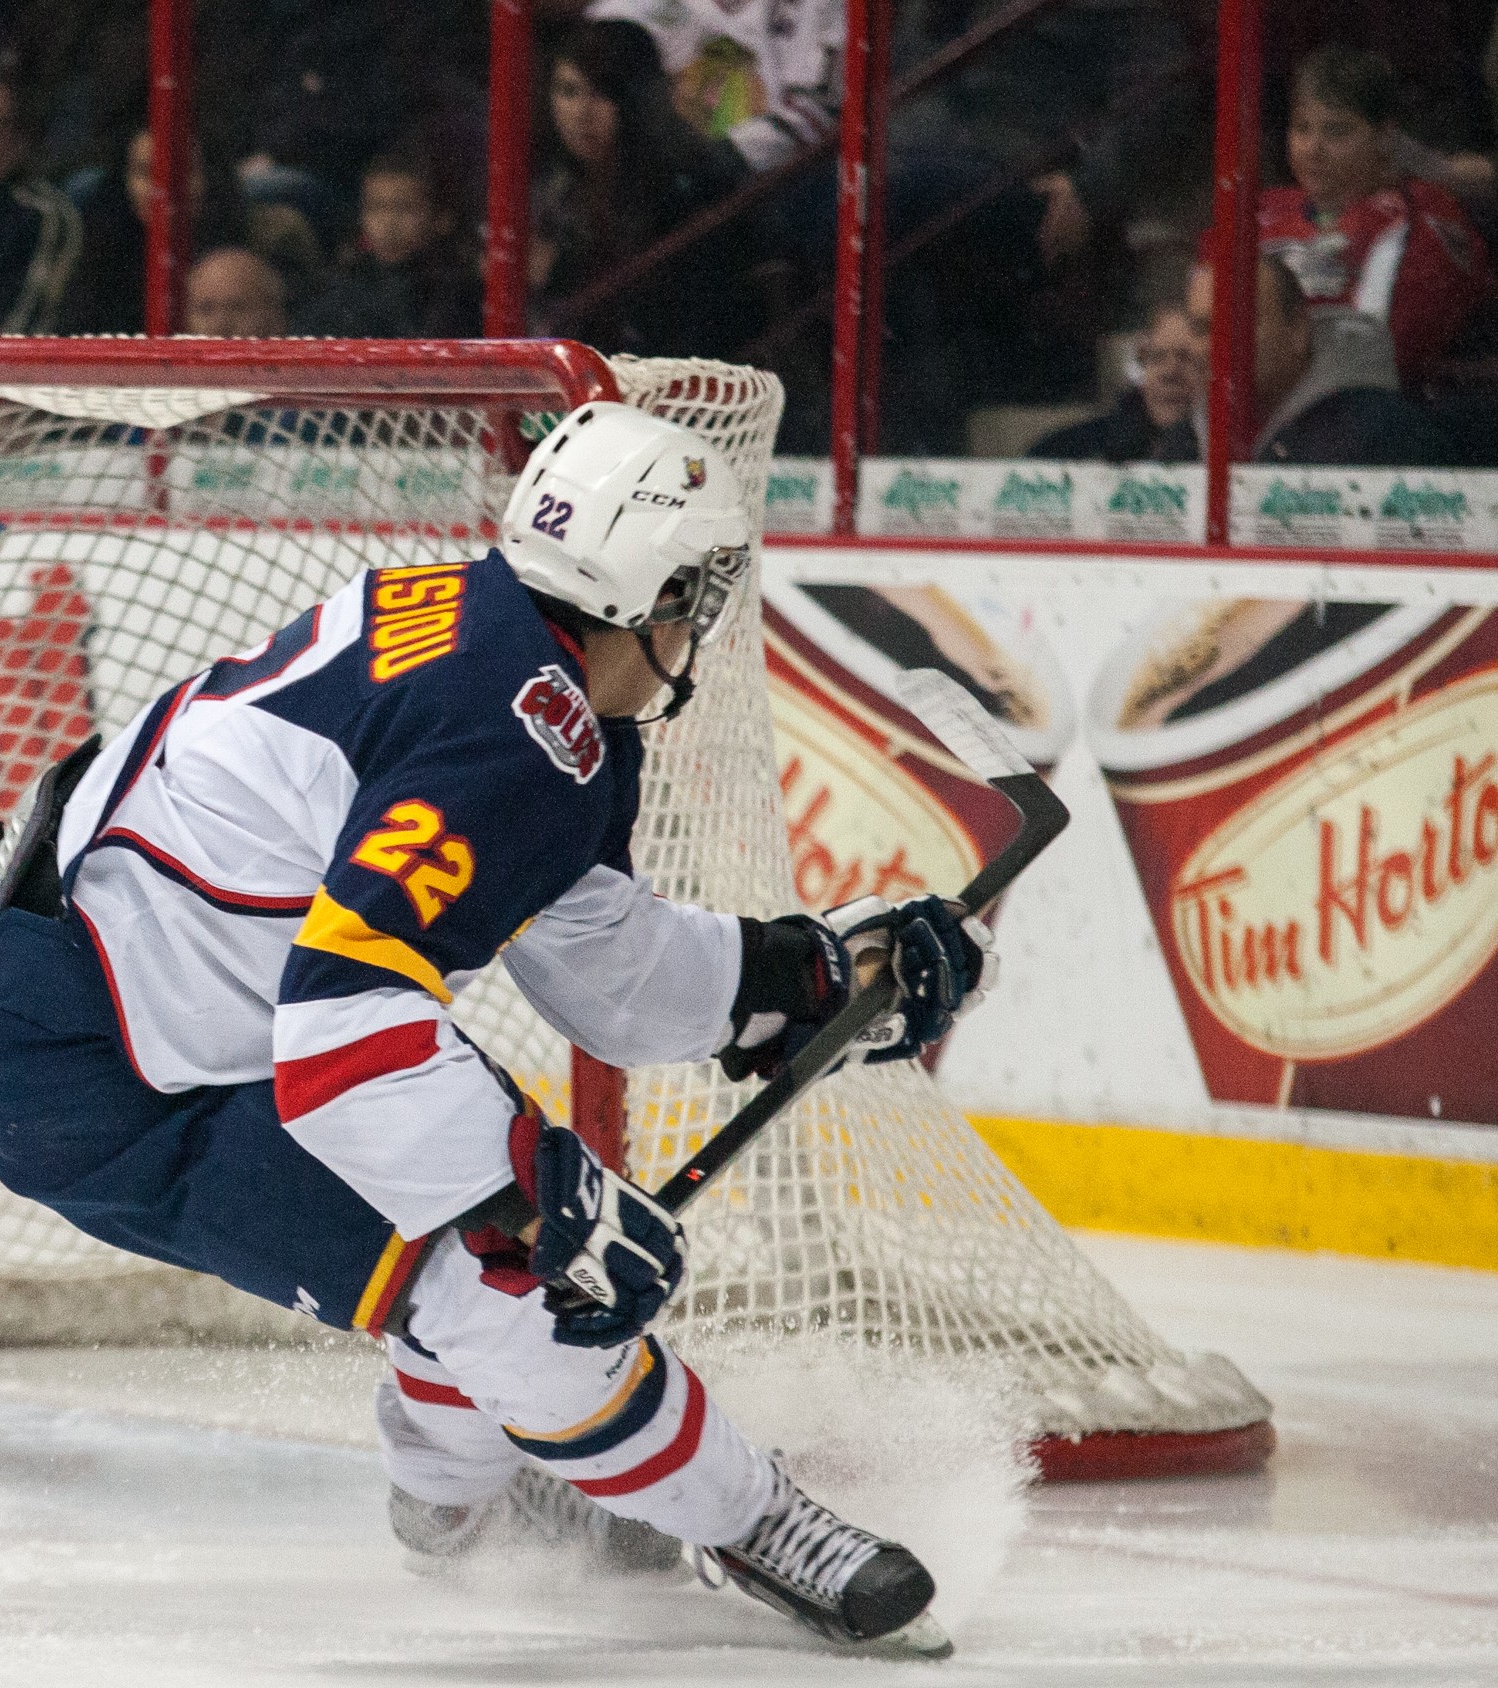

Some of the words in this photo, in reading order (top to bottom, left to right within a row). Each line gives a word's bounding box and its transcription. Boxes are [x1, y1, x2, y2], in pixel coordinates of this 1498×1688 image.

[530, 493, 575, 543] 22
[631, 489, 688, 511] CCM
[350, 798, 477, 931] 22
[1175, 865, 1303, 998] Tim
